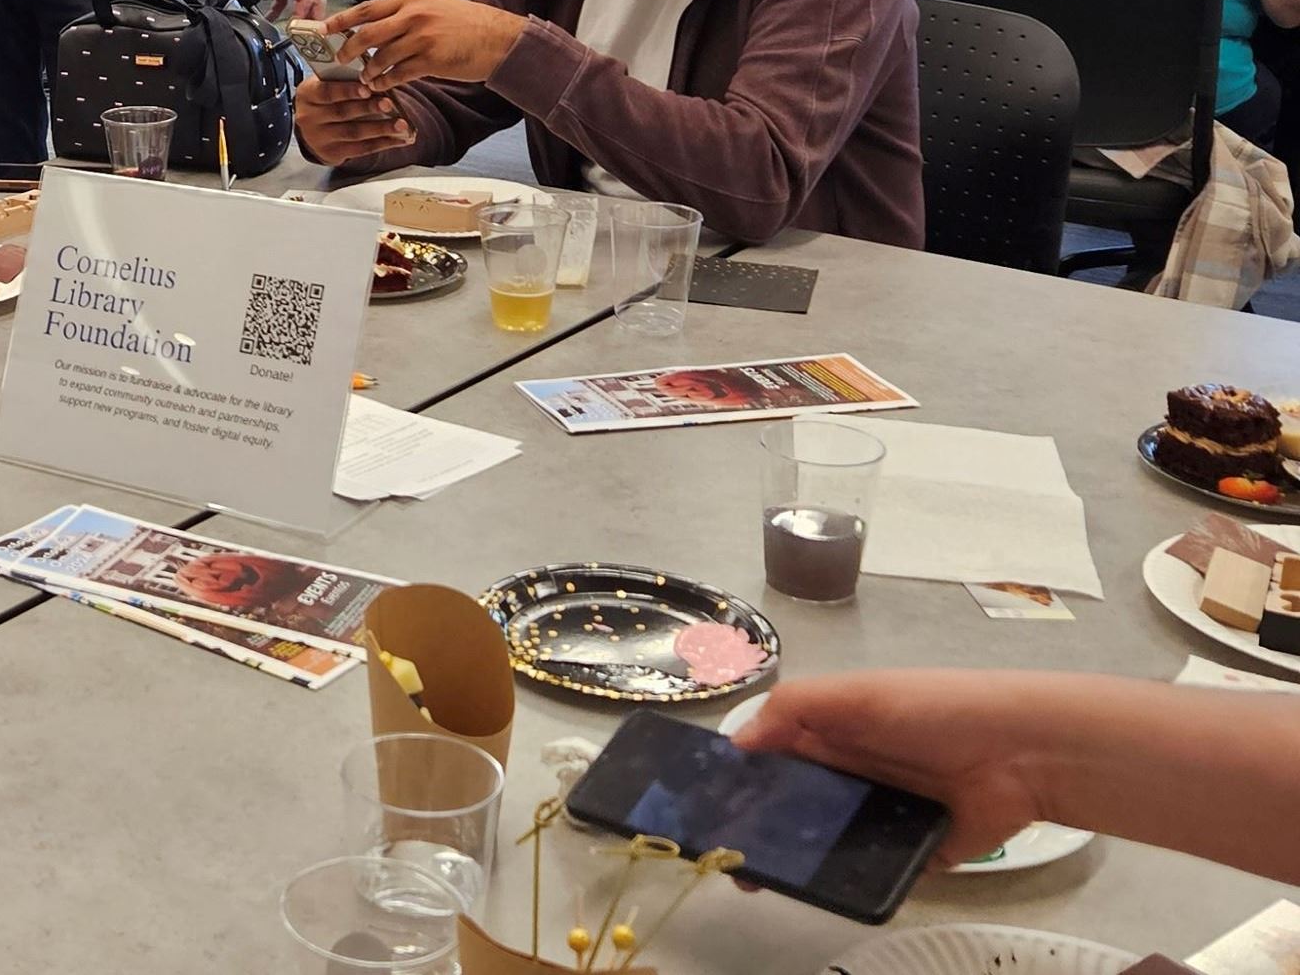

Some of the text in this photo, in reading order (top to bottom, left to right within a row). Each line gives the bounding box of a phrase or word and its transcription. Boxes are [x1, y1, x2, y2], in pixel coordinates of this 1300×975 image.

[57, 245, 176, 289] Cornelius
[49, 277, 145, 323] Library
[44, 310, 192, 363] Foundation
[54, 359, 72, 370] Our
[72, 364, 107, 379] mission
[108, 372, 117, 381] is
[129, 374, 173, 392] fundraise
[173, 384, 182, 394] &
[183, 387, 227, 403] advocate
[229, 393, 243, 406] for
[244, 398, 260, 410] the
[262, 401, 295, 418] library
[249, 364, 294, 382] Donate!
[58, 377, 68, 387] to
[69, 381, 103, 395] expand
[103, 387, 153, 406] community
[154, 397, 196, 414] outreach
[197, 407, 217, 418] and
[59, 394, 93, 407] support
[93, 401, 113, 413] new
[162, 416, 181, 428] and
[182, 419, 210, 434] foster
[211, 426, 241, 441] digital
[297, 571, 338, 606] EVENTS
